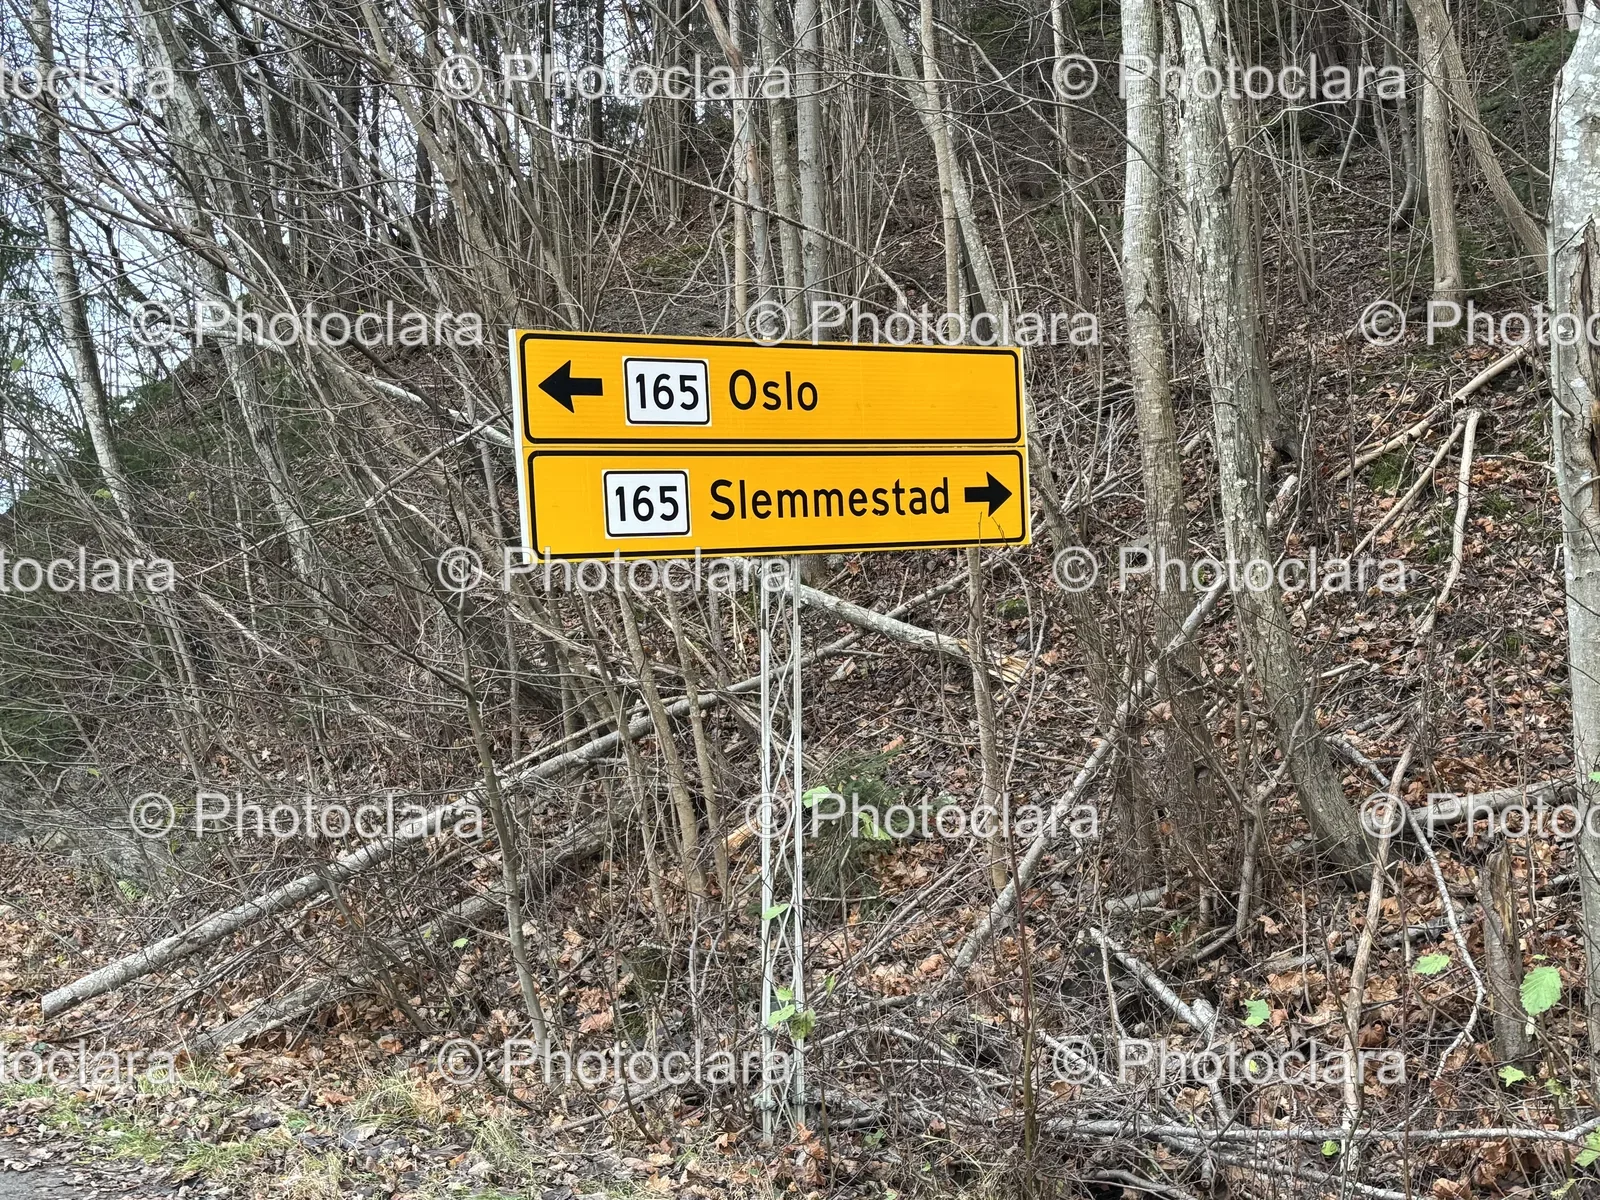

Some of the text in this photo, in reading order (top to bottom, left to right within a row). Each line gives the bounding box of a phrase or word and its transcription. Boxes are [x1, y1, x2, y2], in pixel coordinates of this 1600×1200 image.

[636, 370, 817, 410] 165 Oslo
[616, 477, 949, 521] 165 Slemmestad
